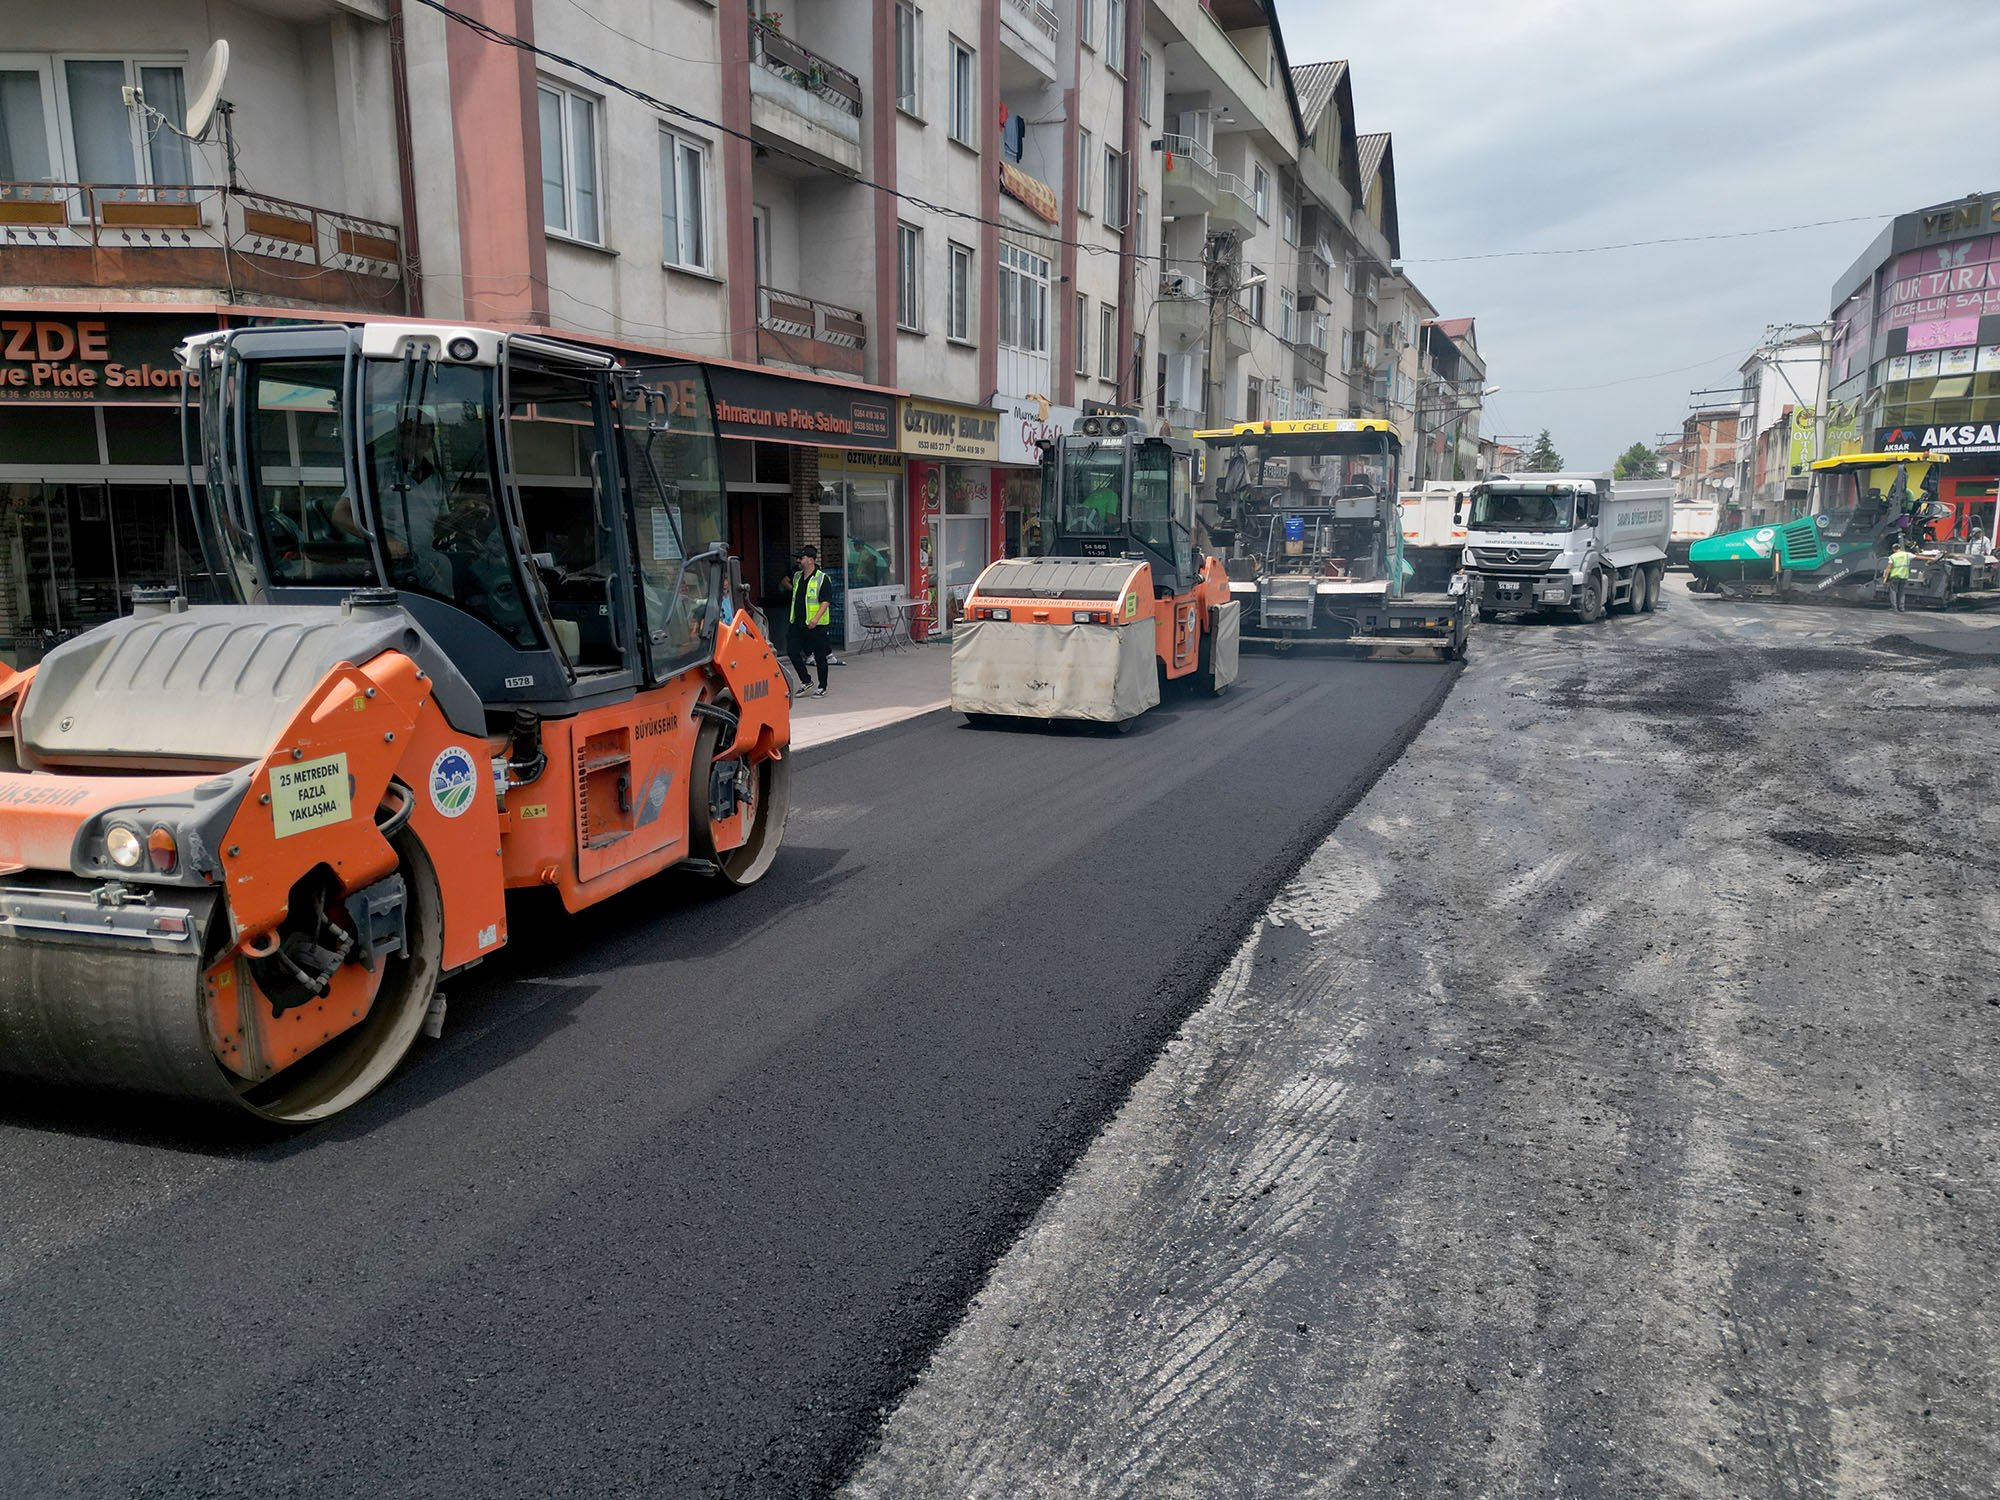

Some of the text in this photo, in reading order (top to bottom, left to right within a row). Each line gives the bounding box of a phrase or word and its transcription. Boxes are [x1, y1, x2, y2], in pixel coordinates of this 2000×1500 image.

[0, 321, 109, 361] ZDE
[32, 362, 98, 387] Pide
[773, 415, 788, 428] ve
[790, 408, 815, 430] Pide
[815, 411, 851, 434] Salonu
[904, 401, 996, 444] ÖZTUNÇ EMLAK
[1884, 443, 1910, 452] AKSAR
[1920, 424, 2000, 447] AKSA
[507, 677, 530, 687] 1578
[743, 679, 769, 703] HAMM
[635, 712, 679, 740] BÜYÜKŞEHİR
[280, 763, 339, 787] 25 METREDEN
[298, 784, 326, 801] FAZLA
[289, 800, 337, 822] YAKLAŞMA
